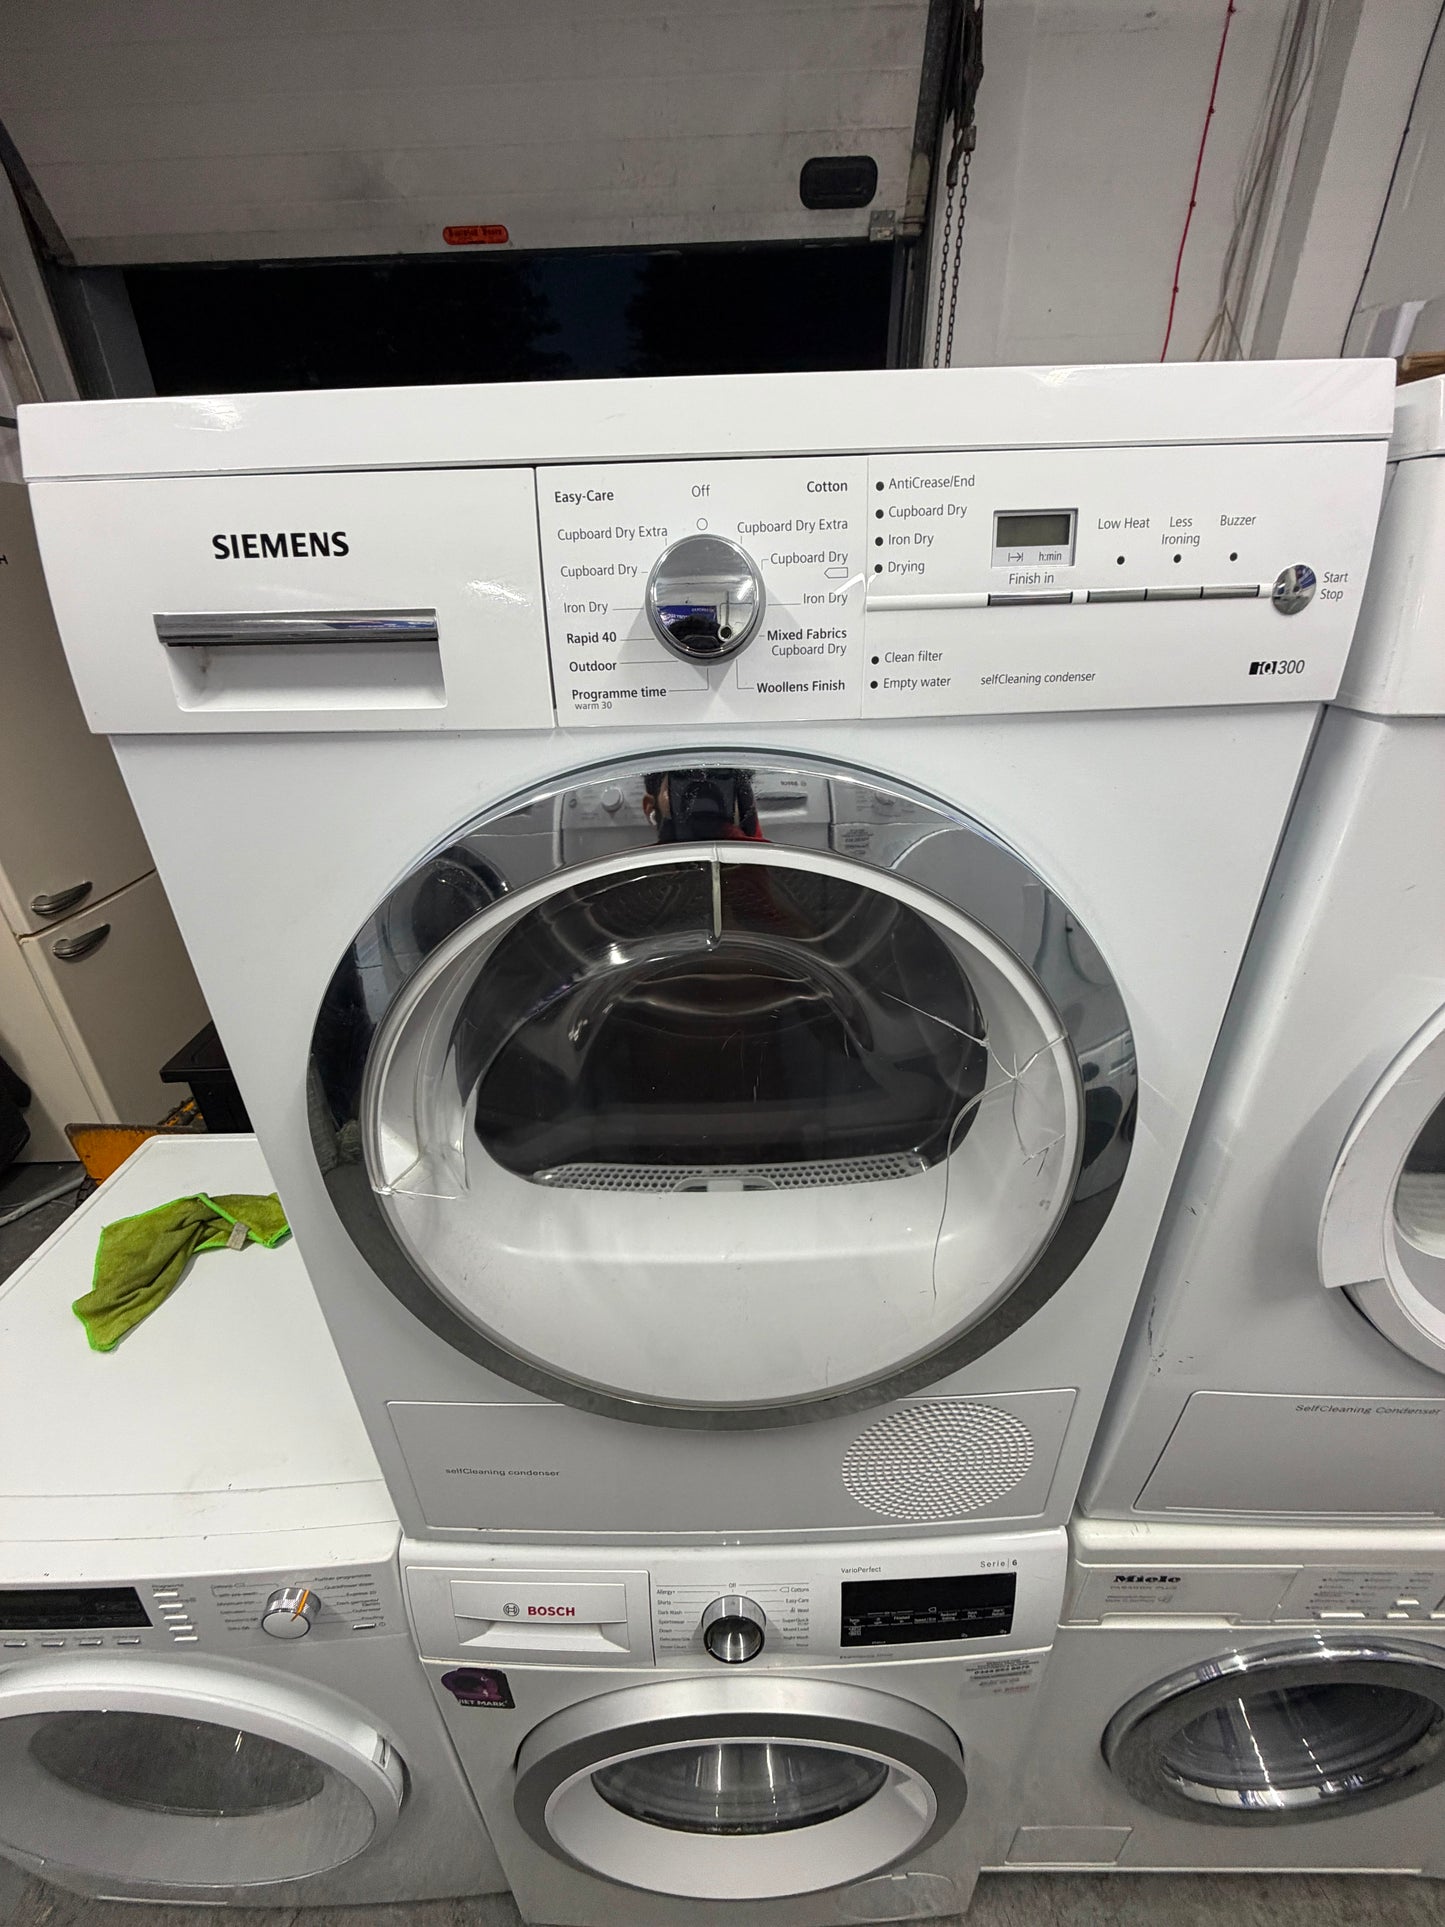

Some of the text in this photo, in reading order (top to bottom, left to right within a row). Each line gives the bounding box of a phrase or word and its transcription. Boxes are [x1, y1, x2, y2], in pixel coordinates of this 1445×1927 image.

[806, 480, 848, 493] Cotton
[889, 475, 976, 490] AntiCrease/End
[554, 489, 614, 506] Easy-Care
[691, 484, 711, 498] Off
[888, 504, 968, 519] Cupboard Dry
[737, 518, 848, 535] Cupboard Dry Extra
[1098, 516, 1151, 530] Low Heat
[1169, 515, 1193, 528] Less
[1219, 513, 1256, 527] Buzzer
[557, 525, 668, 543] Cupboard Dry Extra
[888, 533, 934, 548] Iron Dry
[1161, 532, 1200, 548] Ironing
[212, 531, 350, 560] SIEMENS
[769, 550, 849, 567] Cupboard Dry
[1038, 550, 1062, 562] h:min
[561, 563, 638, 580] Cupboard Dry
[888, 560, 925, 576] Drying
[1009, 571, 1055, 585] Finish in
[1323, 571, 1349, 584] Start
[803, 592, 849, 607] Iron Dry
[1320, 587, 1344, 602] Stop
[563, 601, 609, 616] Iron Dry
[566, 631, 617, 648] Rapid 40
[767, 627, 848, 641] Mixed Fabrics
[771, 642, 847, 659] Cupboard Dry
[885, 649, 943, 664] Clean filter
[569, 660, 618, 673] Outdoor
[883, 676, 951, 691] Empty water
[980, 671, 1096, 687] selfCleaning condenser
[572, 685, 667, 703] Programme time
[757, 679, 846, 695] Woollens Finish
[574, 700, 613, 711] warm 30
[1296, 1405, 1441, 1416] SelfCleaning Condenser
[445, 1467, 560, 1477] selfCleaning condenser
[840, 1566, 882, 1575] VarioPerfect
[980, 1559, 1018, 1569] Serie 6
[1113, 1575, 1182, 1584] Miele
[527, 1605, 576, 1618] BOSCH
[477, 1700, 506, 1708] MARK
